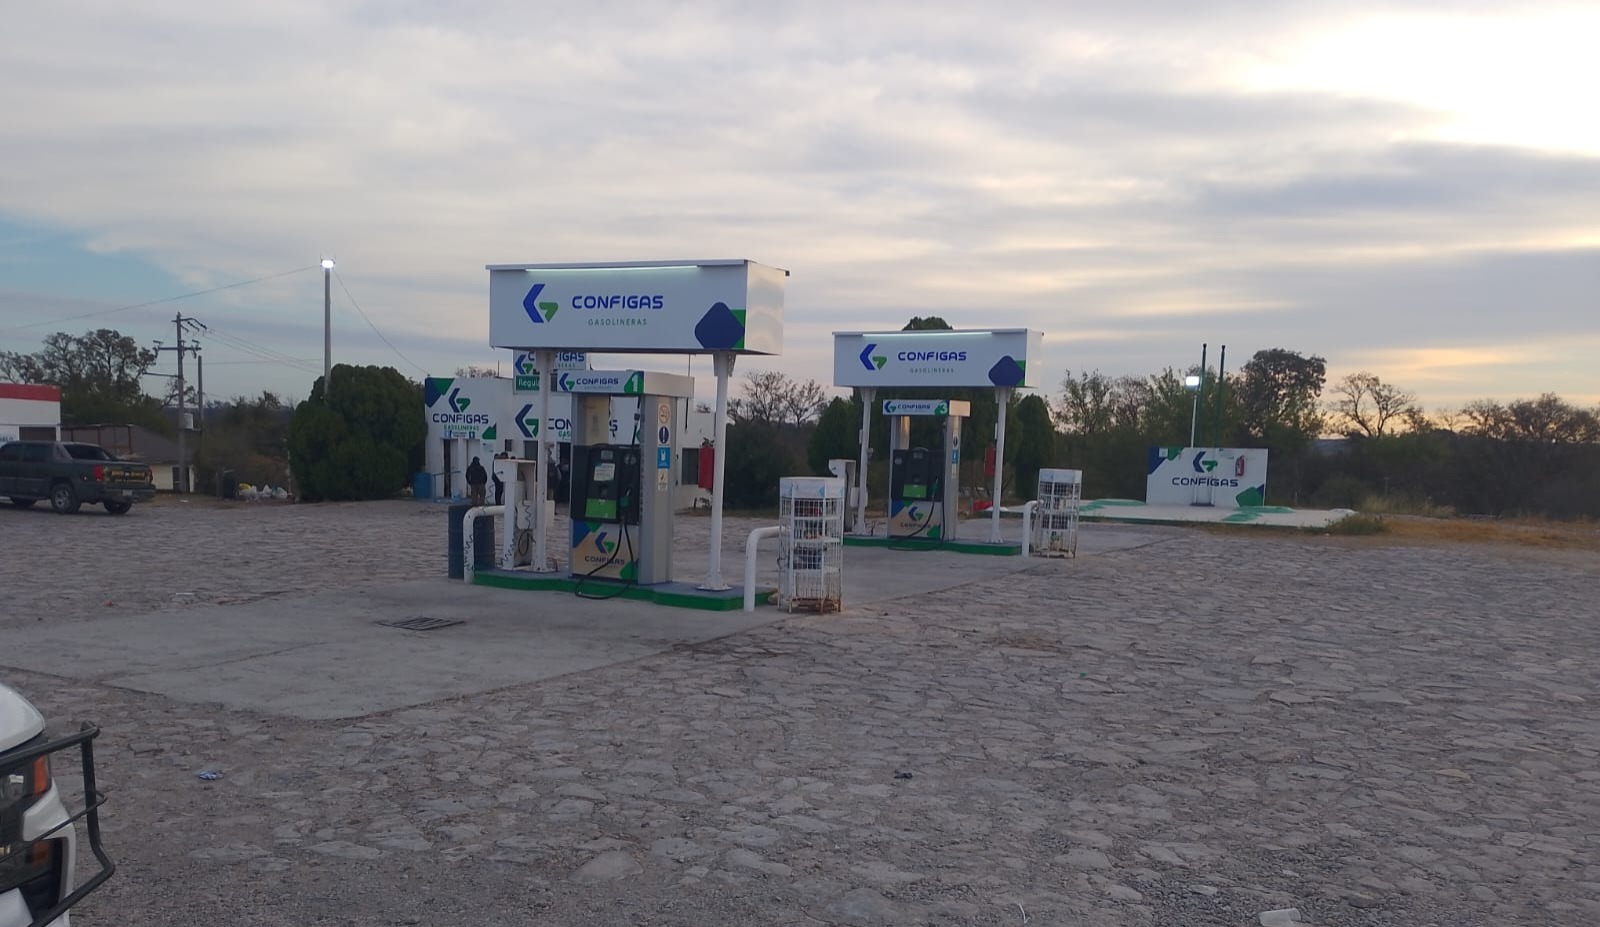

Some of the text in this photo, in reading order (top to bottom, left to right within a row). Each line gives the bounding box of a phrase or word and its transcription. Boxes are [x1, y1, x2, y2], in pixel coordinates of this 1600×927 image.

[572, 295, 664, 310] CONFIGAS
[588, 318, 647, 327] GASOLINERAS
[897, 351, 967, 361] CONFIGAS
[576, 377, 619, 385] CONFIGAS
[631, 374, 639, 393] 1
[939, 402, 948, 414] 3
[432, 413, 489, 424] CONFIGAS
[1171, 477, 1239, 487] CONFIGAS
